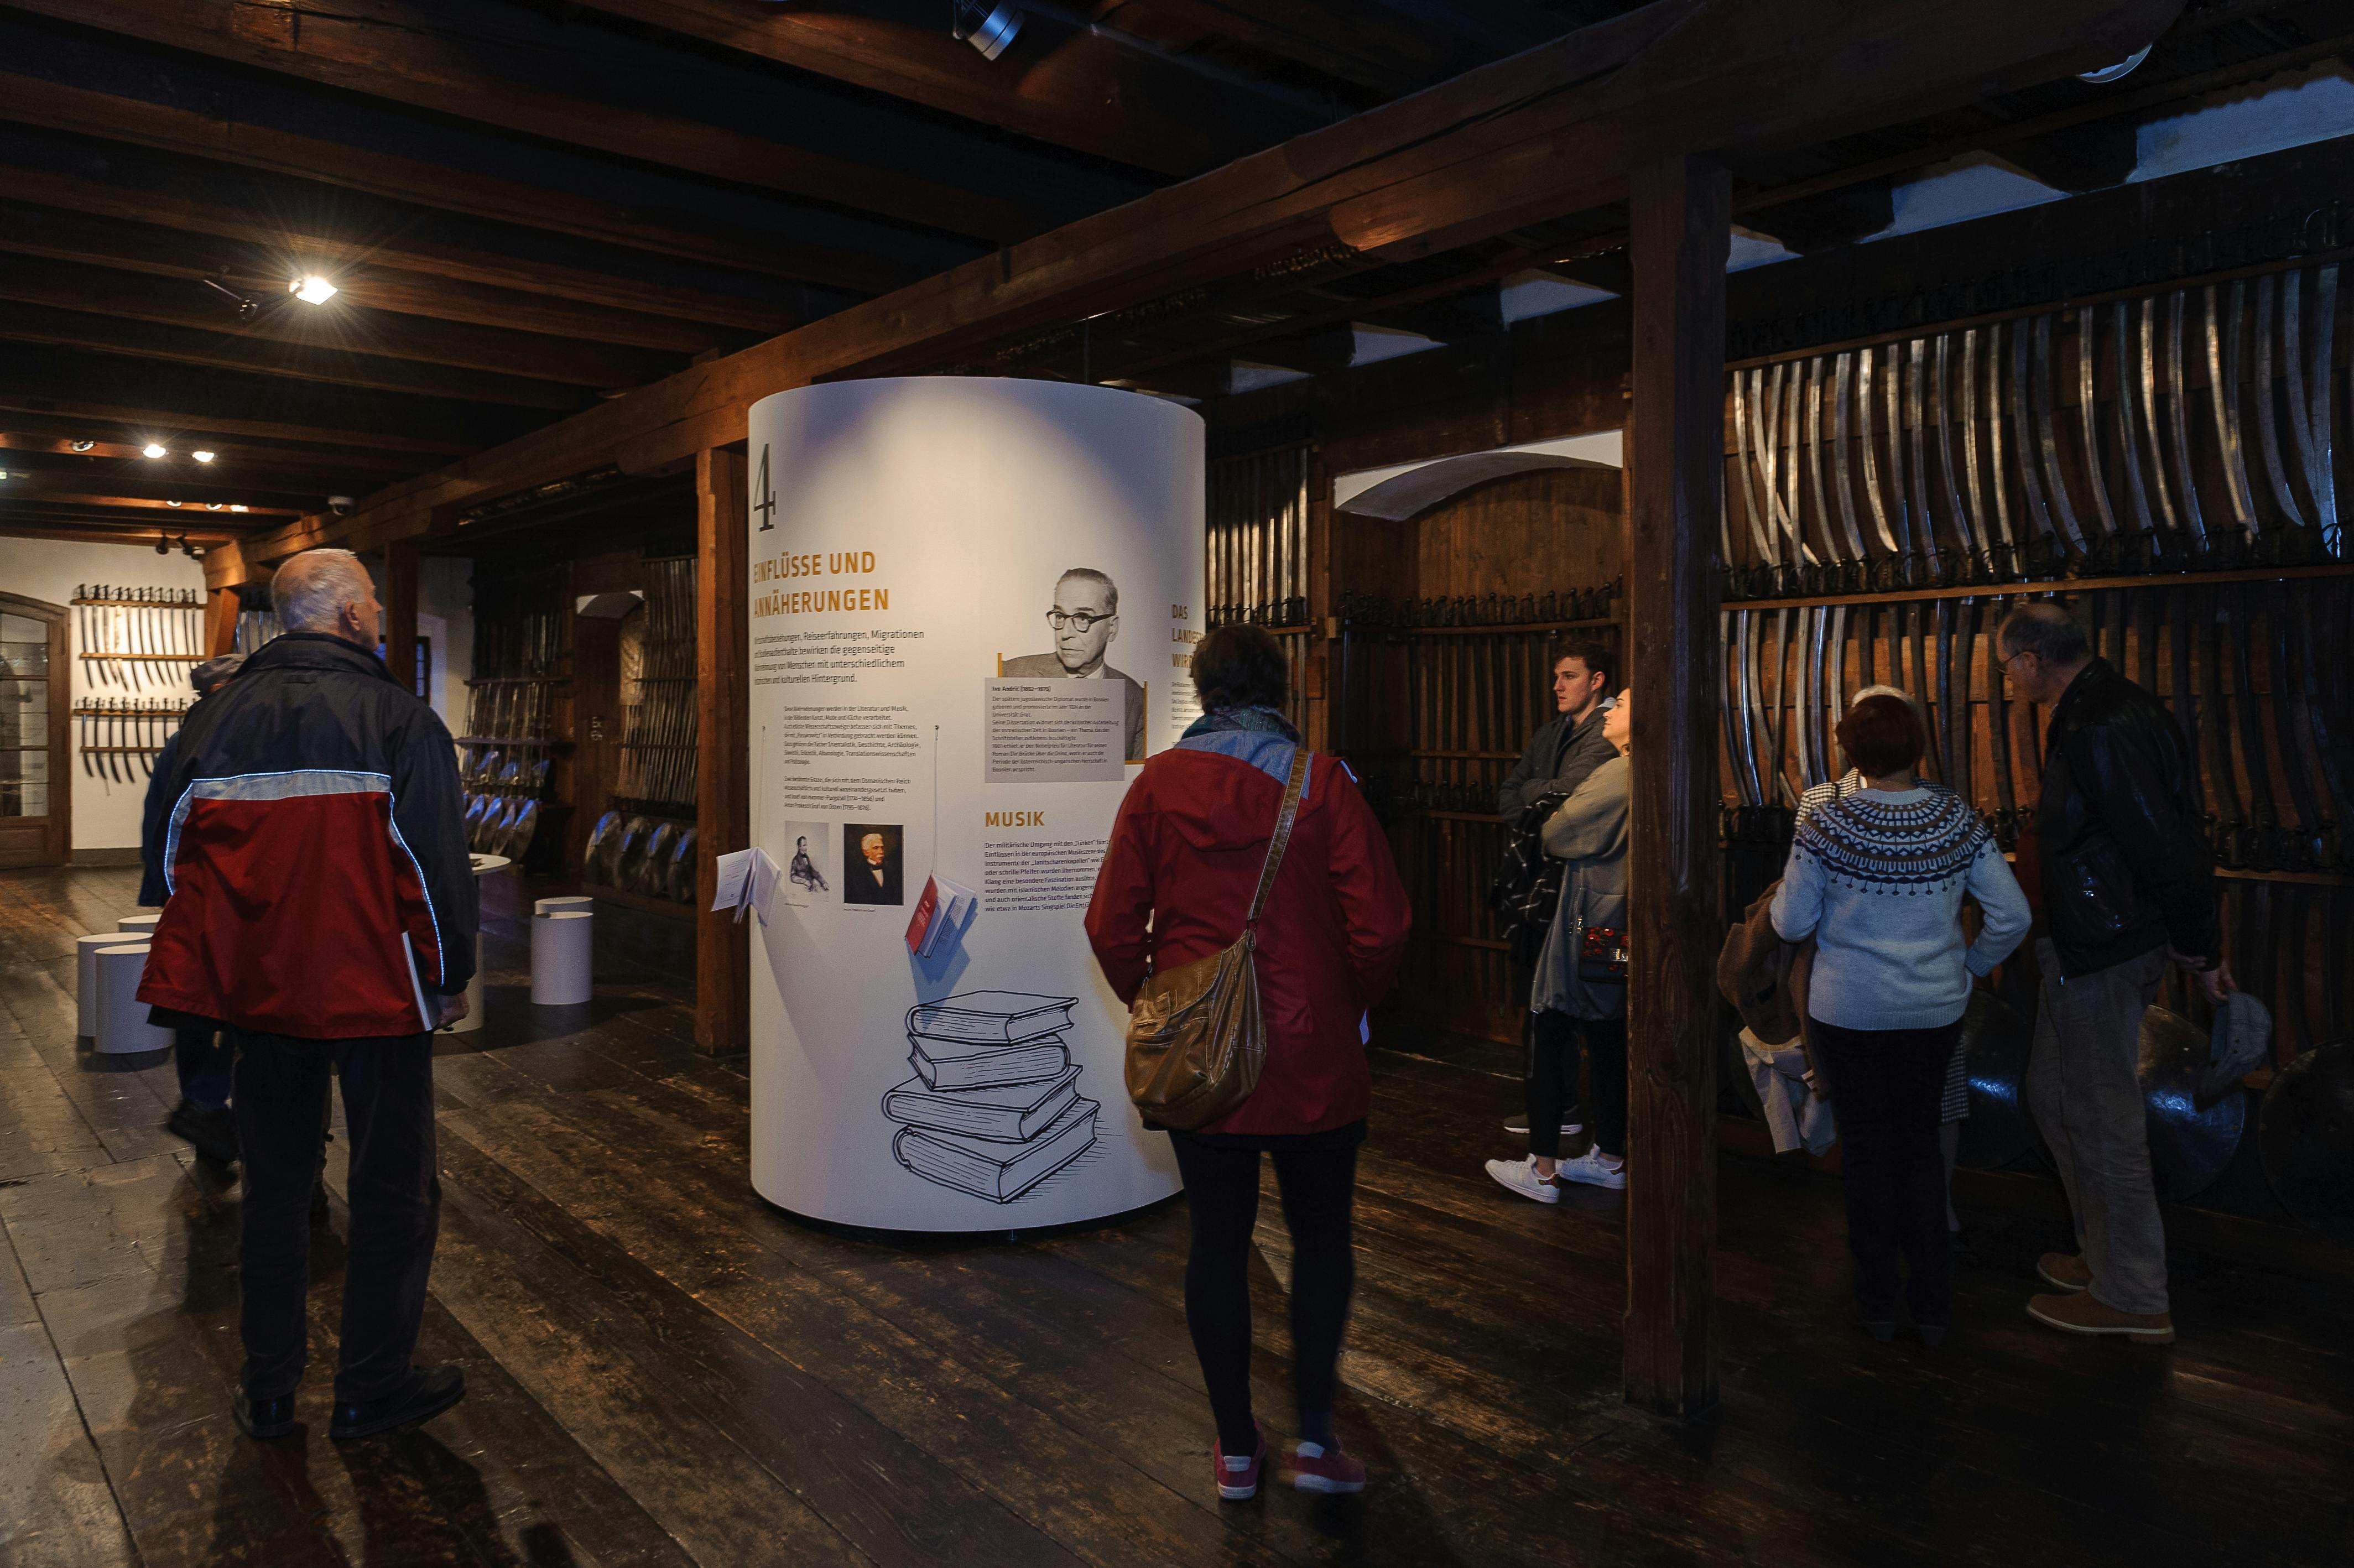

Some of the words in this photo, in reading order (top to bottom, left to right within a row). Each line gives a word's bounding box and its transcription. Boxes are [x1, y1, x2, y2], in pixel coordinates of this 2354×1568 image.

[754, 444, 776, 532] 4
[754, 551, 822, 584] EINFLÜSSE
[830, 551, 876, 574] UND
[754, 589, 889, 618] ANNÄHERUNGEN
[1172, 604, 1188, 620] DAS
[804, 631, 869, 642] Reiseerfahrungen,
[871, 629, 924, 640] Migrationen
[830, 645, 841, 654] die
[843, 644, 895, 655] gegenseitige
[831, 659, 905, 668] unterschiedlichem
[812, 674, 857, 685] Hintergrund.
[985, 811, 1045, 827] MUSIK
